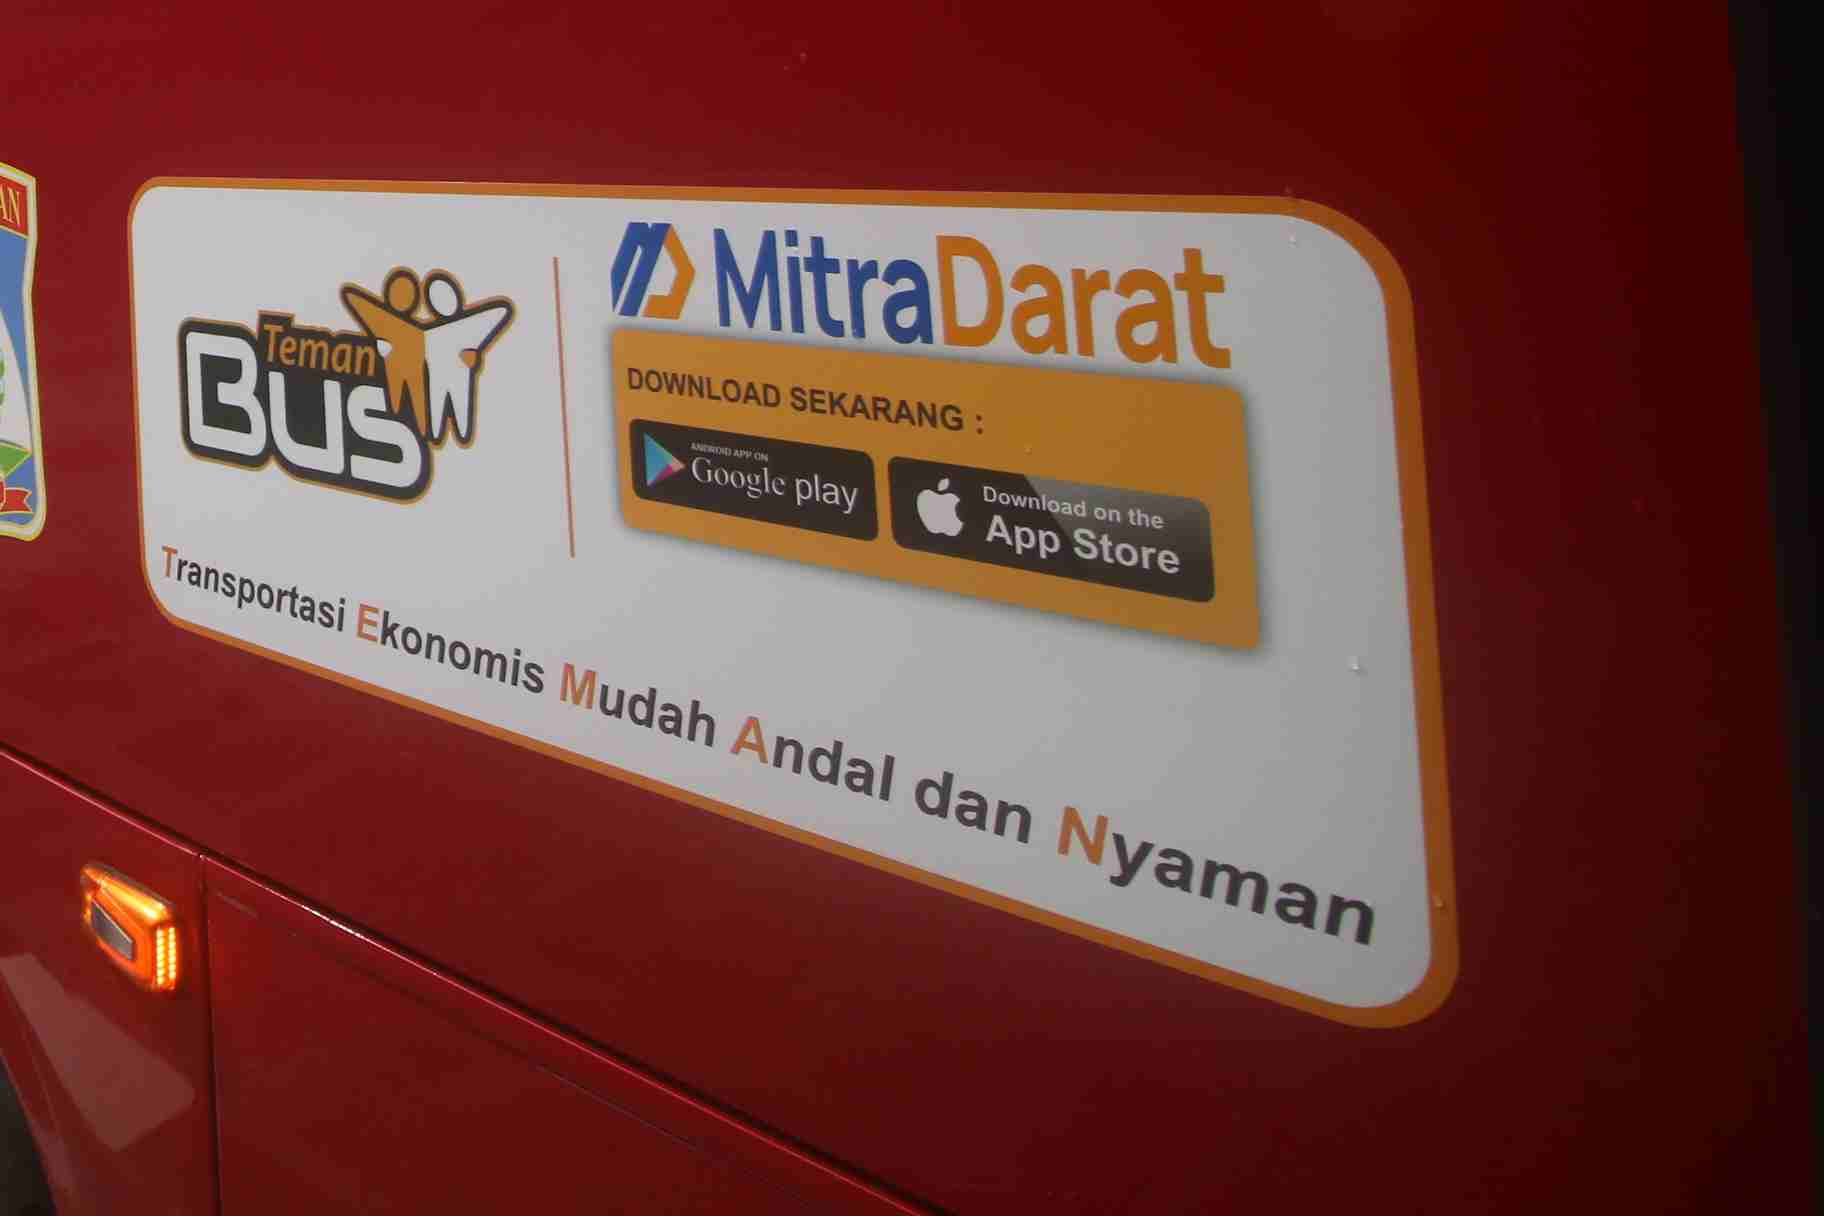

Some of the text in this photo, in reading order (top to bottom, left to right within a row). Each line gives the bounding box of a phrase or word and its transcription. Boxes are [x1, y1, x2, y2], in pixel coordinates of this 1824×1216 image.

[263, 324, 376, 378] Teman
[627, 367, 781, 408] DOWNLOAD
[789, 386, 965, 433] SEKARANG
[690, 441, 769, 463] ANDROID APP ON
[690, 456, 860, 515] Google play
[982, 485, 1166, 530] Download on the
[985, 514, 1181, 576] App Store
[161, 546, 1377, 947] Transportasi Ekonomis Mudah Andal dan Nyaman
